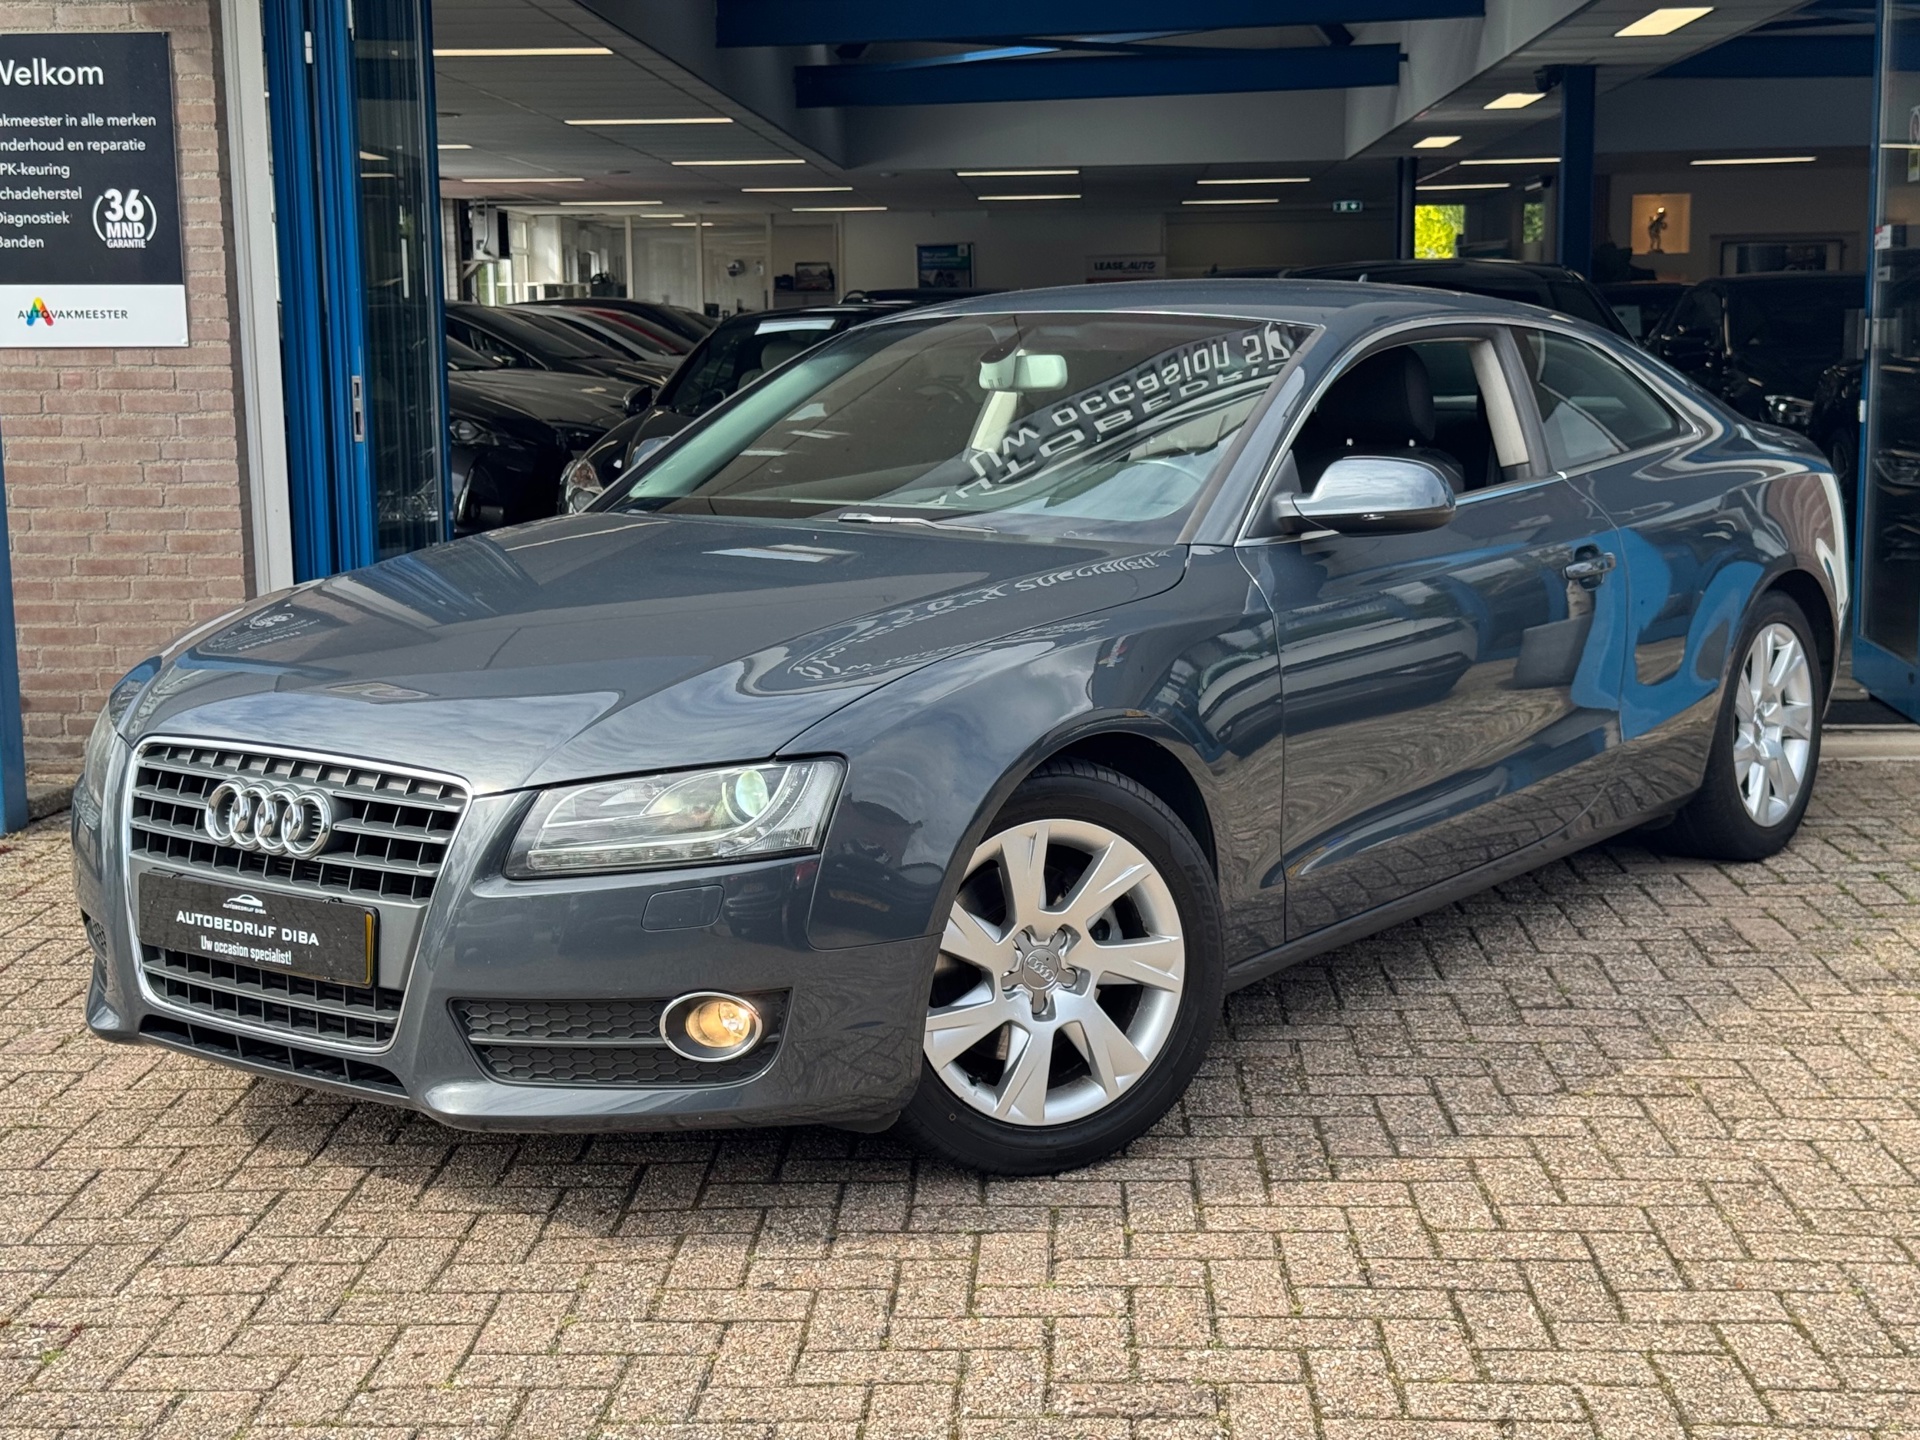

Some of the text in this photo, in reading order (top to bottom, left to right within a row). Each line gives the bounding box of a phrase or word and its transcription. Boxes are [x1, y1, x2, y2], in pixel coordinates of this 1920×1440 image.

[65, 114, 78, 127] in
[80, 113, 104, 127] alle
[107, 113, 156, 127] merken
[67, 142, 84, 151] en
[87, 138, 146, 154] reparatie
[104, 188, 145, 222] 36
[105, 221, 146, 239] MND
[106, 238, 147, 249] GARANTIE
[17, 309, 128, 320] AUTOVAKMEESTER
[175, 910, 320, 947] AUTOBEDRIJF DIBA
[200, 934, 292, 965] Uw occasion specialist!
